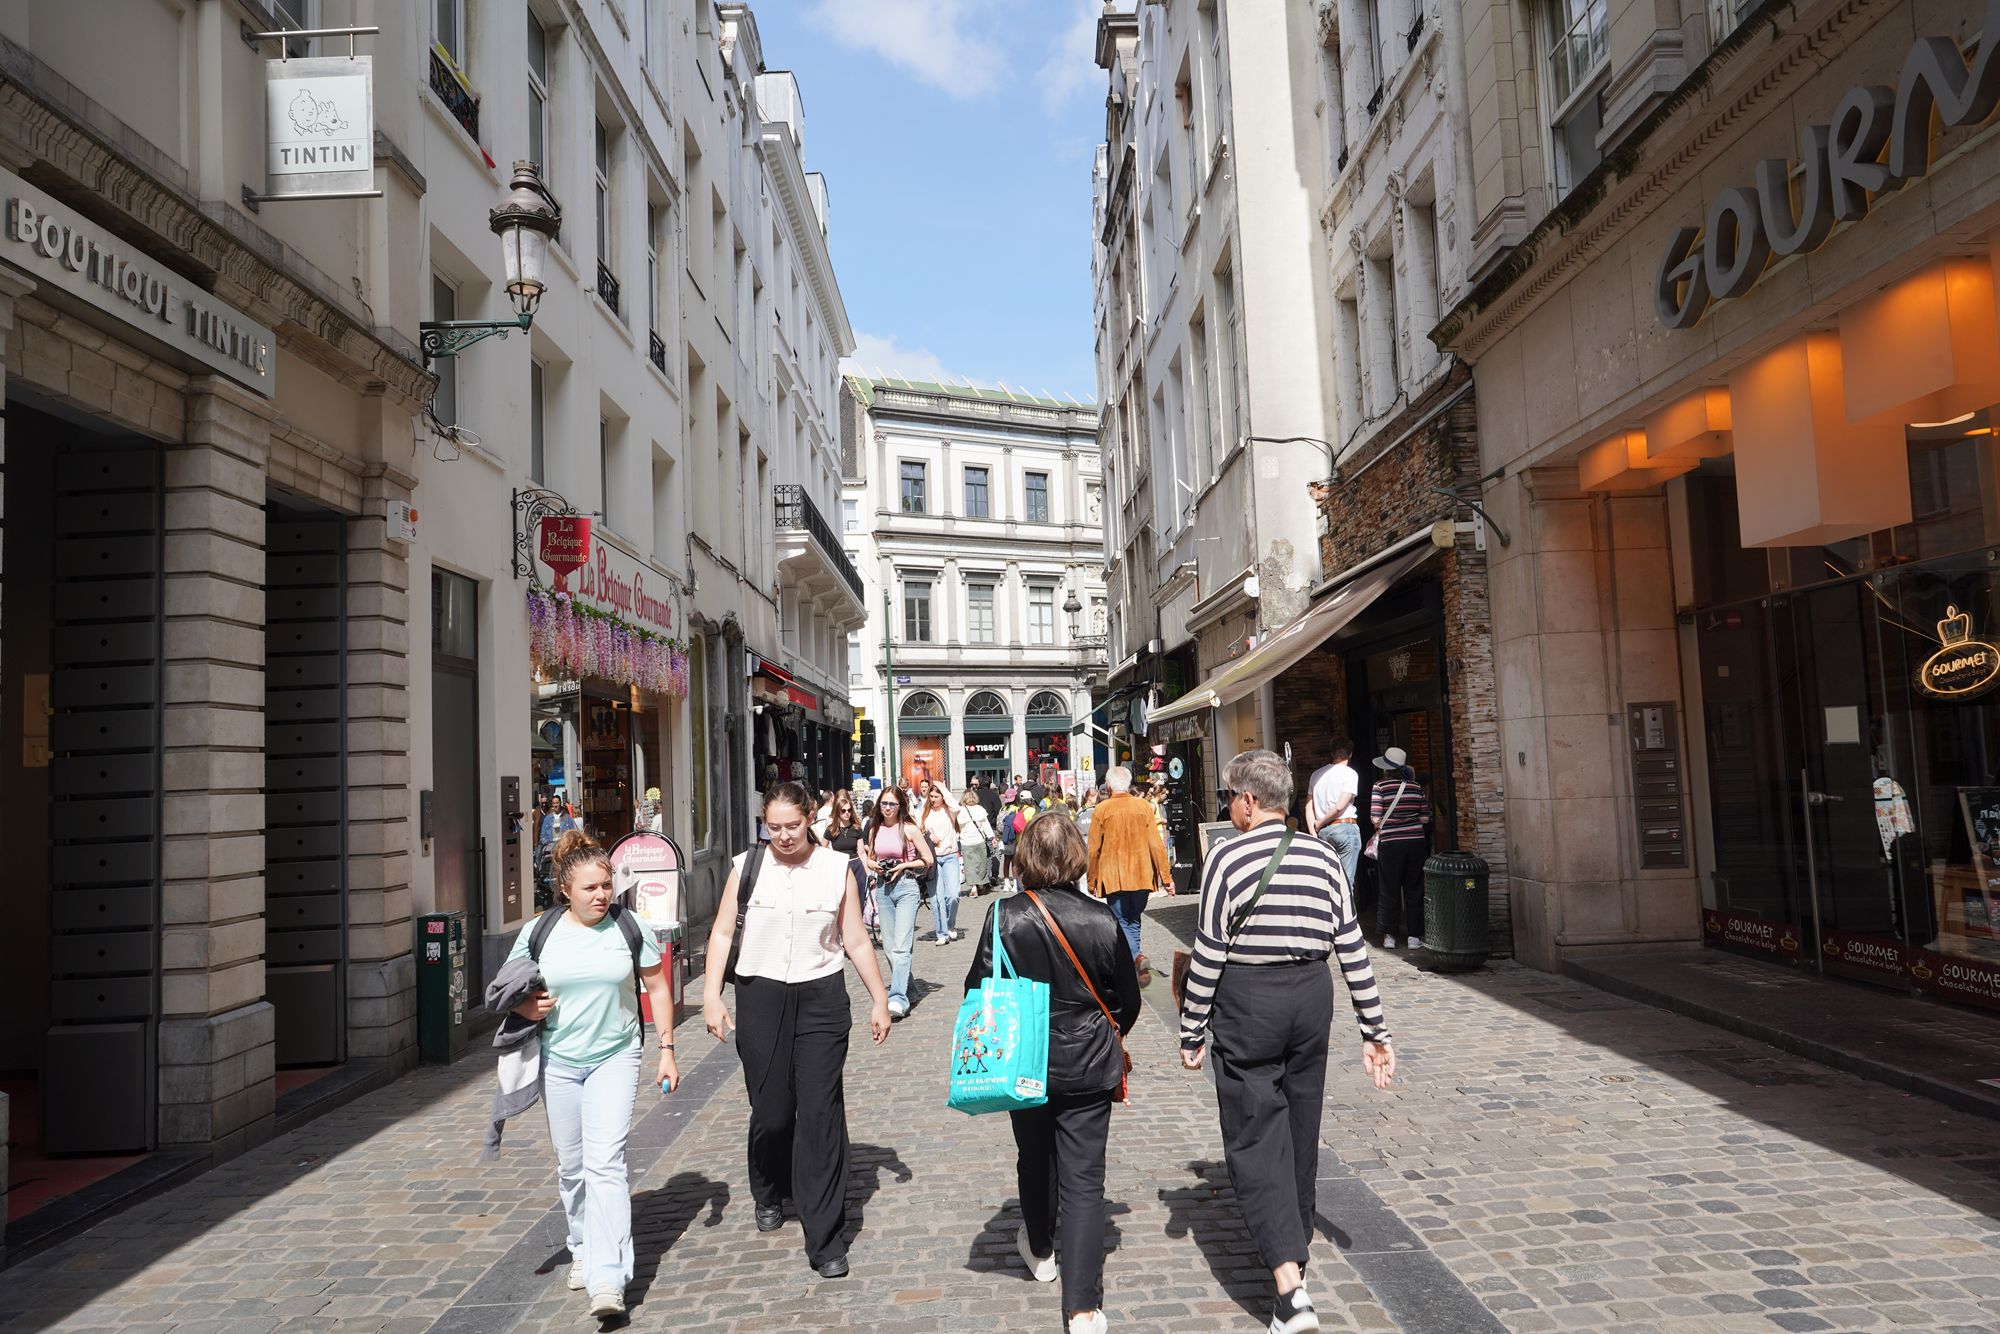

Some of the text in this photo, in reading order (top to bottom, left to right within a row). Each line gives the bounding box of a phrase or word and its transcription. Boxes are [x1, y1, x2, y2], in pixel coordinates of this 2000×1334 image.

[280, 145, 355, 165] TINTIN
[17, 201, 269, 377] BOUTIQUE TINTIN
[558, 519, 574, 532] La
[547, 530, 583, 549] Belgique
[541, 549, 588, 563] Gourmande
[577, 540, 672, 630] La Belgique Gourmande
[1932, 651, 1988, 677] GOURMET
[975, 744, 1005, 752] TISSOT
[1084, 759, 1090, 771] 2
[623, 853, 667, 864] Gourmande
[631, 843, 664, 855] Belgique
[1728, 918, 1774, 938] GOURMET
[1725, 930, 1760, 945] Chocolaterie
[1760, 939, 1776, 952] belge
[1848, 940, 1899, 961] GOURMET
[1844, 952, 1884, 968] Chocolaterie
[1884, 960, 1903, 974] belge
[1938, 976, 1990, 996] Chocolaterie
